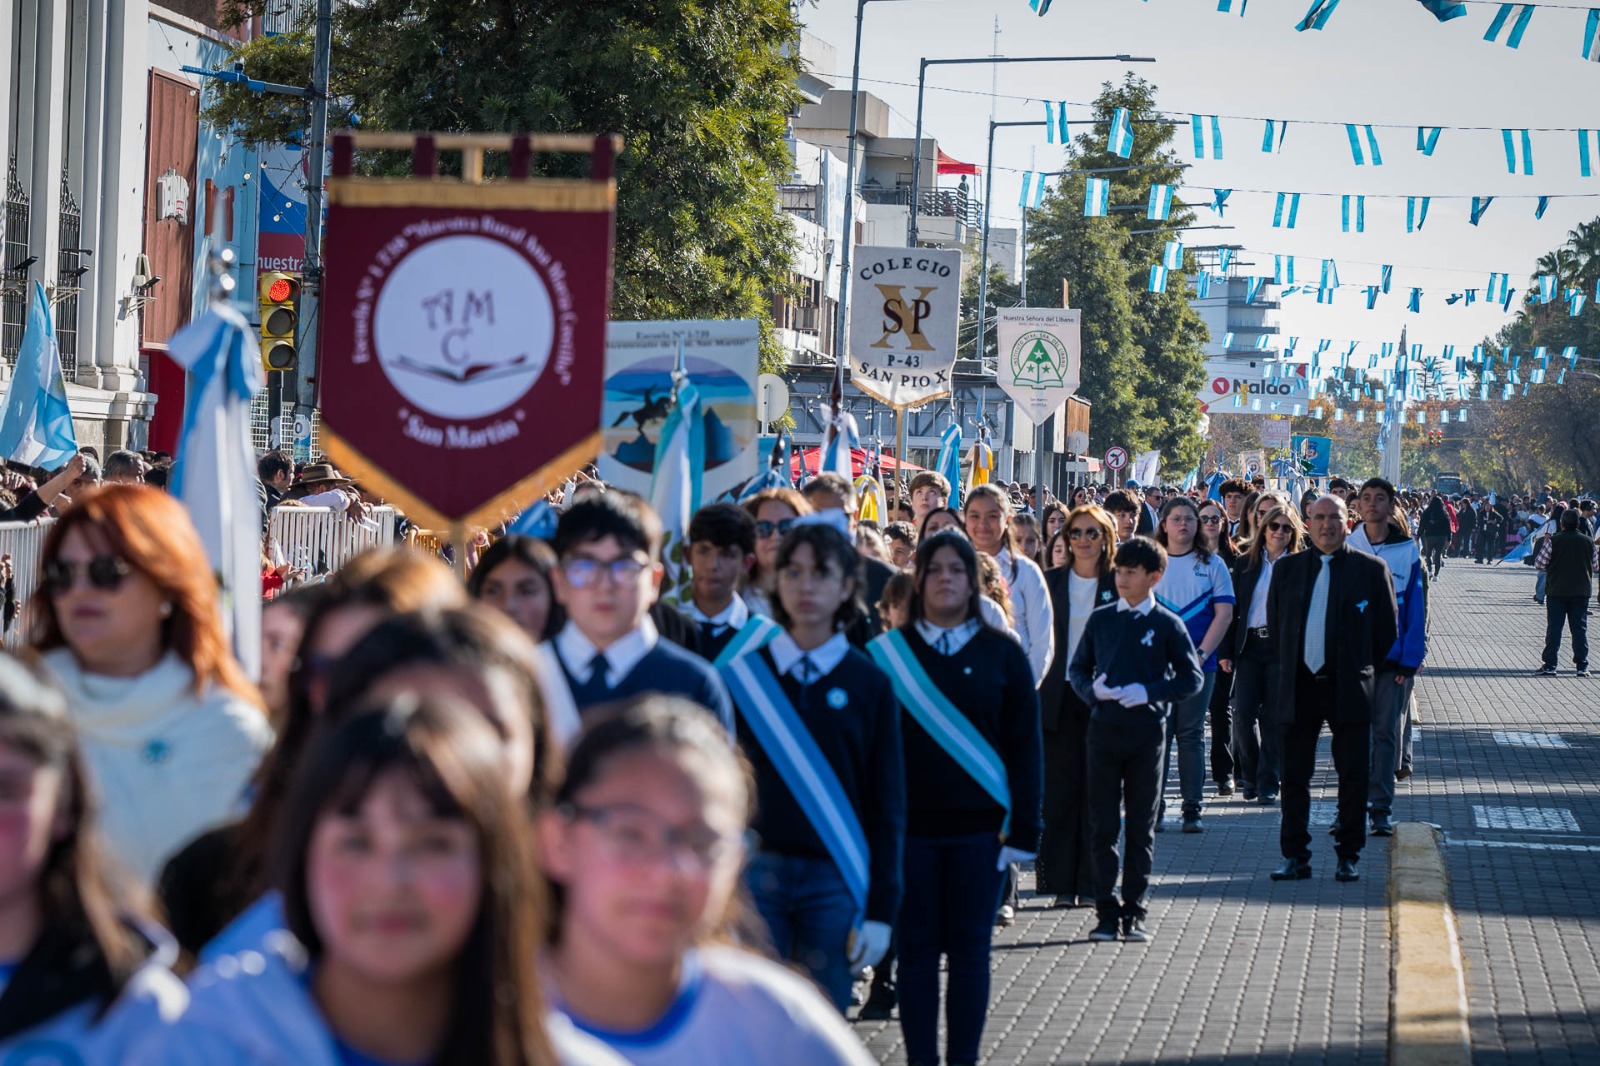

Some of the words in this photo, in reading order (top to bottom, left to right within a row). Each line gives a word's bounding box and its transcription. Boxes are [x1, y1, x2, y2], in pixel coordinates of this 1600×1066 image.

[860, 257, 951, 280] COLEGIO
[887, 354, 920, 368] P-43
[859, 362, 893, 384] SAN
[901, 374, 930, 387] PIO
[934, 369, 948, 384] X
